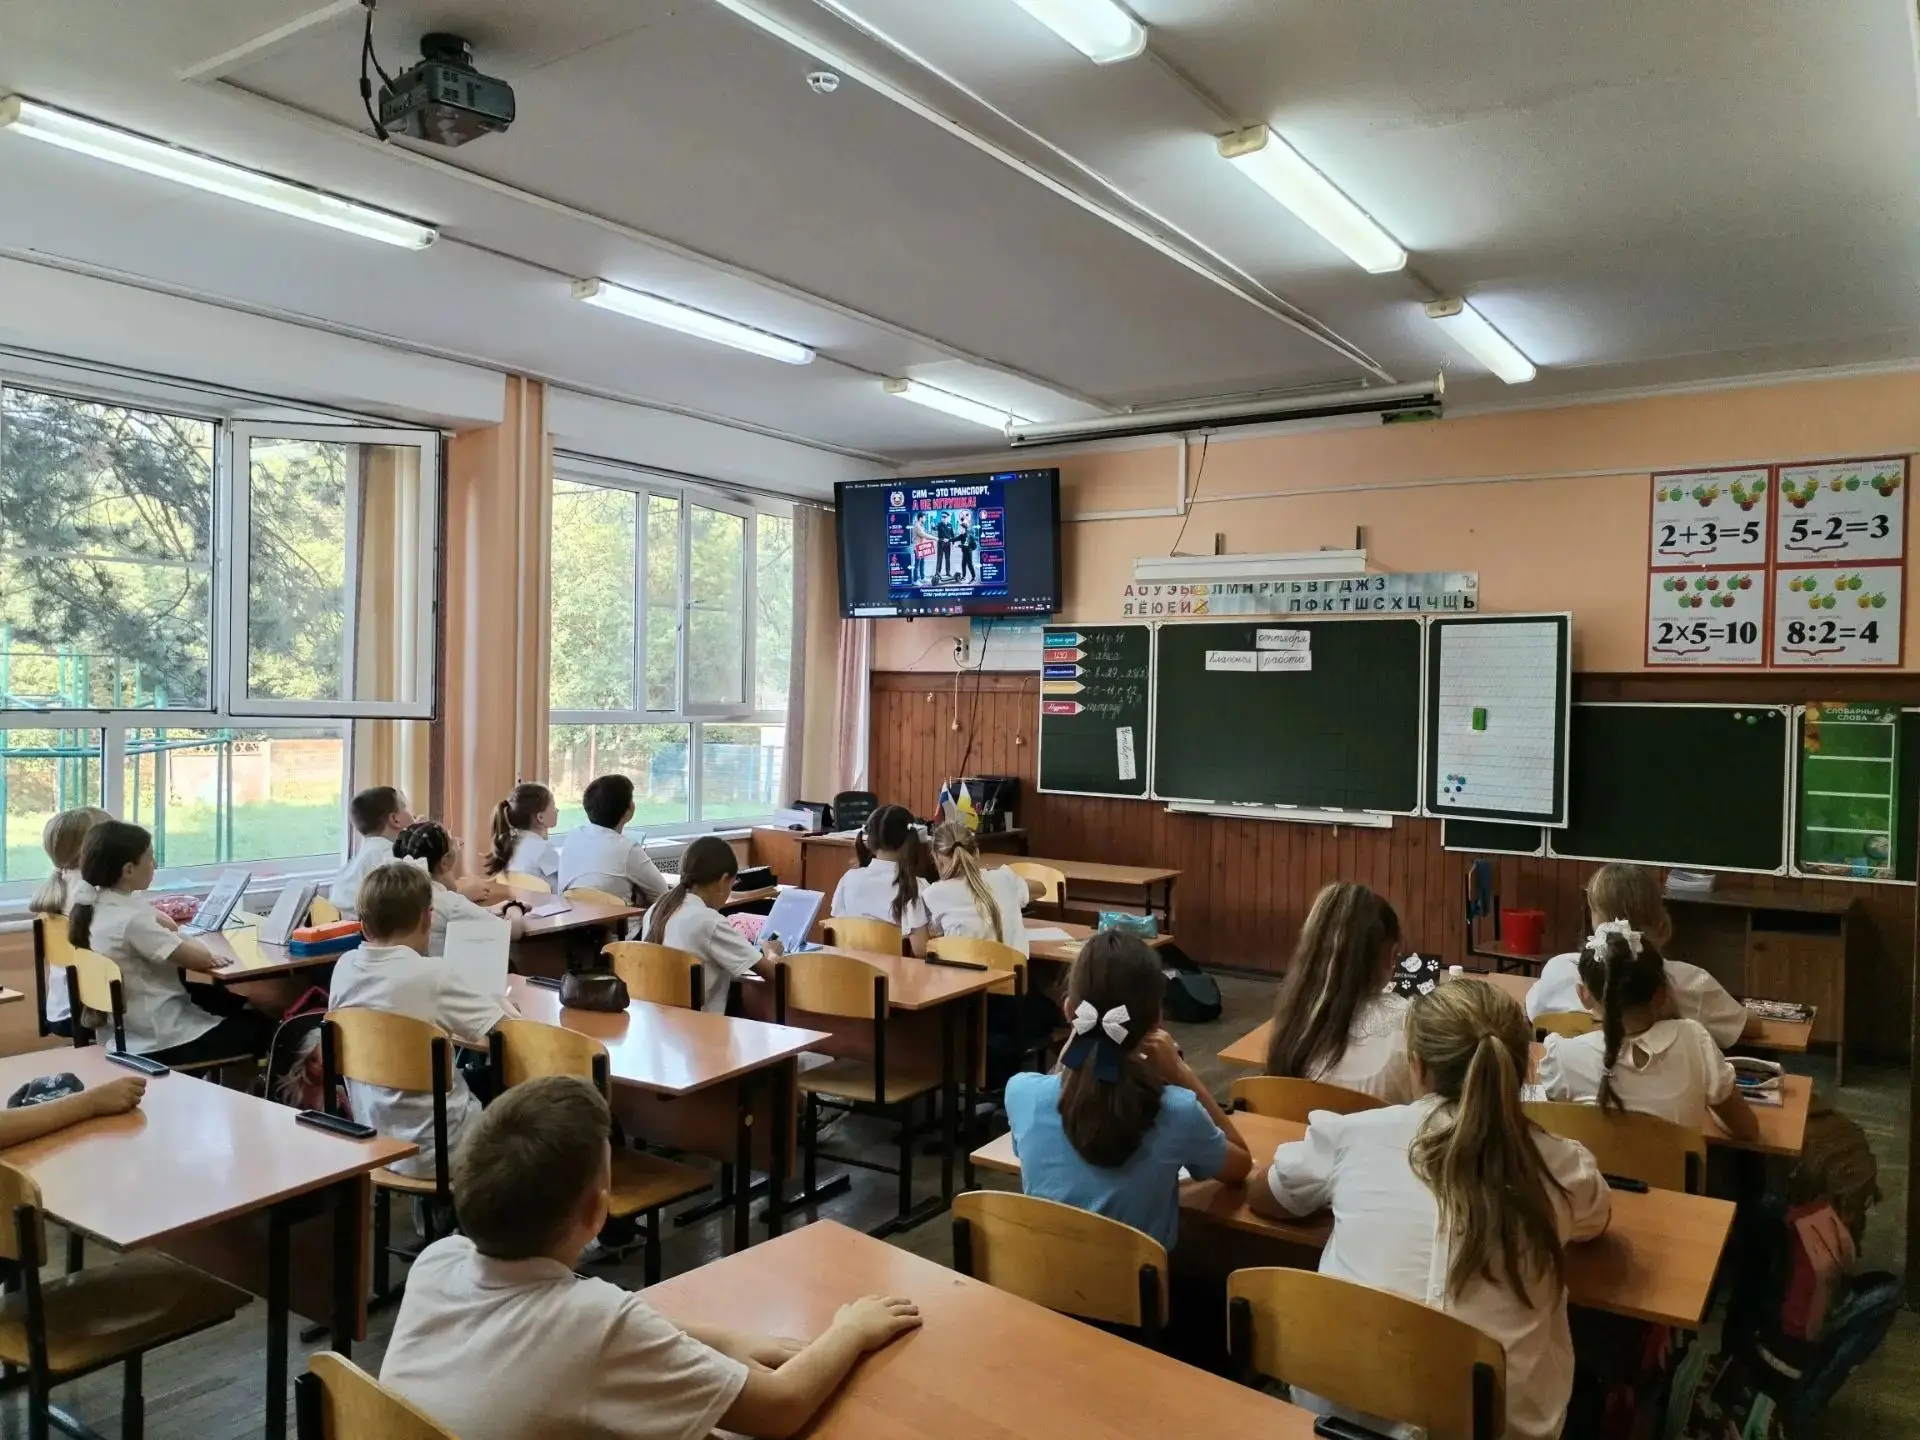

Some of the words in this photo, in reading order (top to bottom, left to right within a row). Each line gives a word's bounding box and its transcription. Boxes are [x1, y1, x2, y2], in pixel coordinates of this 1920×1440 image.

[912, 489, 927, 498] СИМ
[936, 488, 948, 498] ЭТО
[950, 486, 990, 496] ТРАНСПОРТ,
[1659, 521, 1760, 548] 2+3=5
[1790, 514, 1890, 542] 5-2=3
[1258, 630, 1307, 647] сентября
[1786, 620, 1879, 644] 8:2=4
[1825, 707, 1880, 715] СЛОВАРНЫЕ
